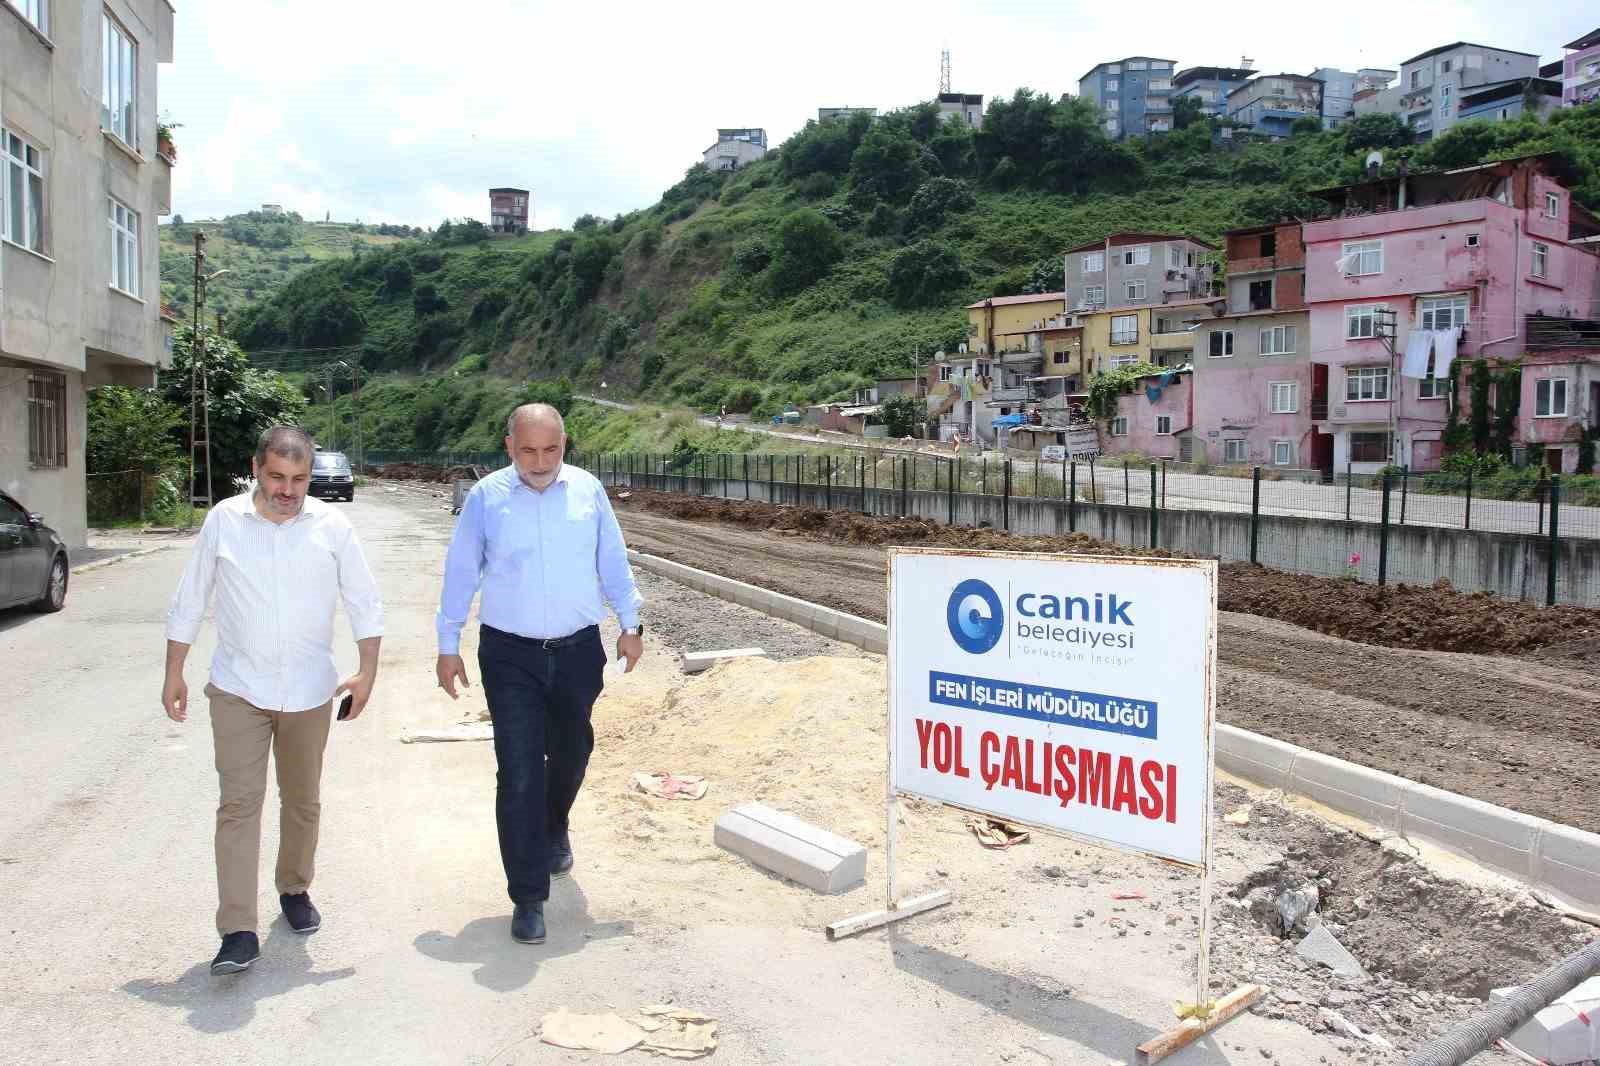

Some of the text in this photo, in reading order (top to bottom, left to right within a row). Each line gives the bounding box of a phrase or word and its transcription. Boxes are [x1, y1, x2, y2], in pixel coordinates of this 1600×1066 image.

[1016, 592, 1135, 627] canik
[1017, 621, 1134, 649] belediyesi
[936, 679, 1150, 729] FEN İŞLERİ MÜDÜRLÜĞÜ
[915, 718, 1177, 824] YOL ÇALIŞMASI
